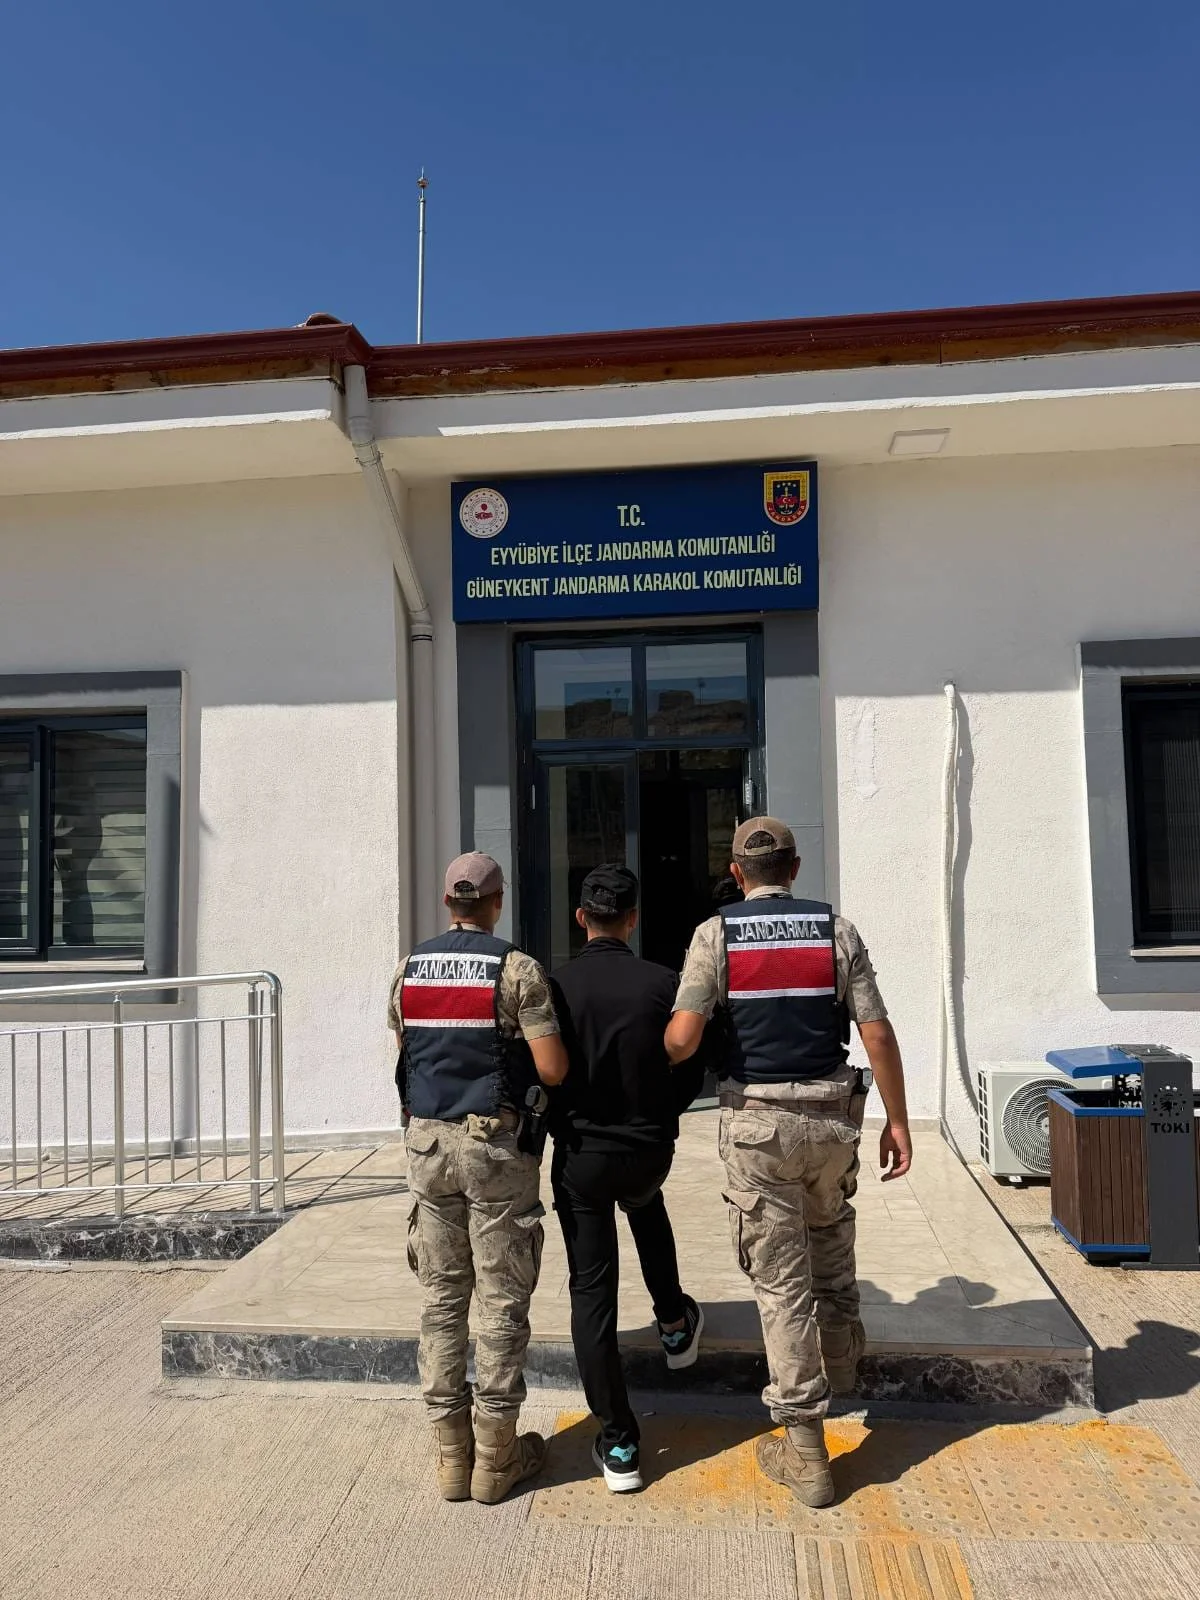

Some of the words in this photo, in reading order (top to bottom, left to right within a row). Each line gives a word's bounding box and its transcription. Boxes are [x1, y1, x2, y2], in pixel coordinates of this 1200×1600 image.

[617, 504, 646, 527] T.C.
[491, 542, 559, 566] EYYÜBİYE
[562, 541, 593, 566] İLÇE
[596, 540, 675, 562] JANDARMA
[677, 530, 776, 558] KOMUTANLIĞI
[466, 577, 550, 599] GÜNEYKENT
[552, 575, 630, 596] JANDARMA
[633, 571, 701, 592] KARAKOL
[703, 563, 802, 589] KOMUTANLIĞI
[736, 919, 822, 941] JANDARMA
[412, 960, 488, 980] JANDARMA
